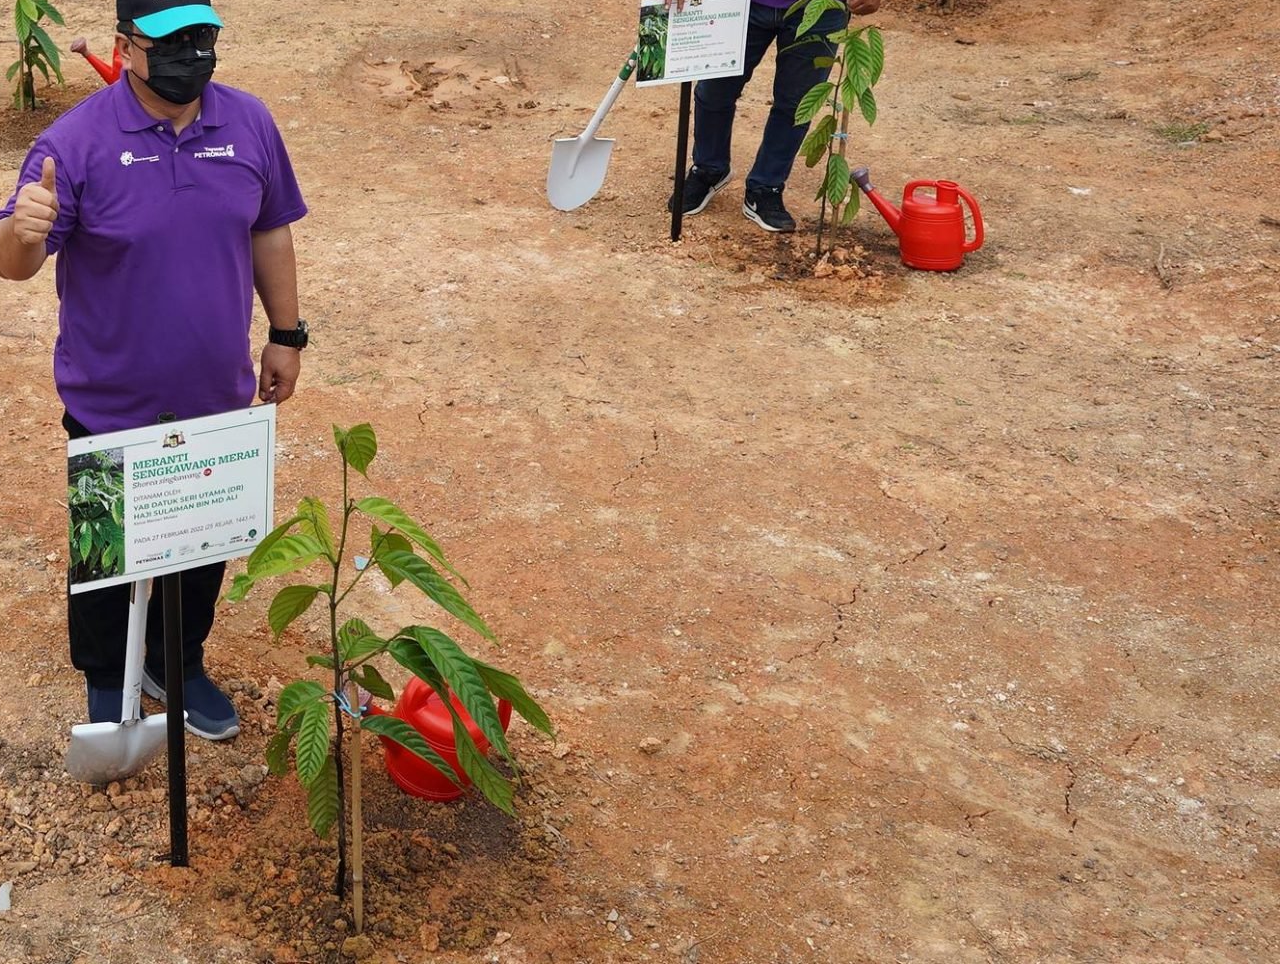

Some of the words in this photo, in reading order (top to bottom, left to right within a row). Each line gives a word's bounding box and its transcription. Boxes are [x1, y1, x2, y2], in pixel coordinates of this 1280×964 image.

[132, 452, 189, 471] MERANTI
[132, 457, 216, 481] SENGKAWANG
[218, 448, 260, 465] MERAH
[133, 492, 163, 503] DITANAM
[133, 503, 150, 511] YAB
[151, 498, 178, 508] DATUK
[180, 495, 197, 503] SERI
[199, 488, 226, 499] UTAMA
[228, 484, 244, 494] (DR)
[133, 511, 152, 520] HAJI
[153, 502, 195, 517] SULAIMAN
[196, 500, 210, 508] BIN
[211, 496, 225, 505] MD
[226, 494, 238, 502] ALI
[135, 555, 164, 565] PETRONAS
